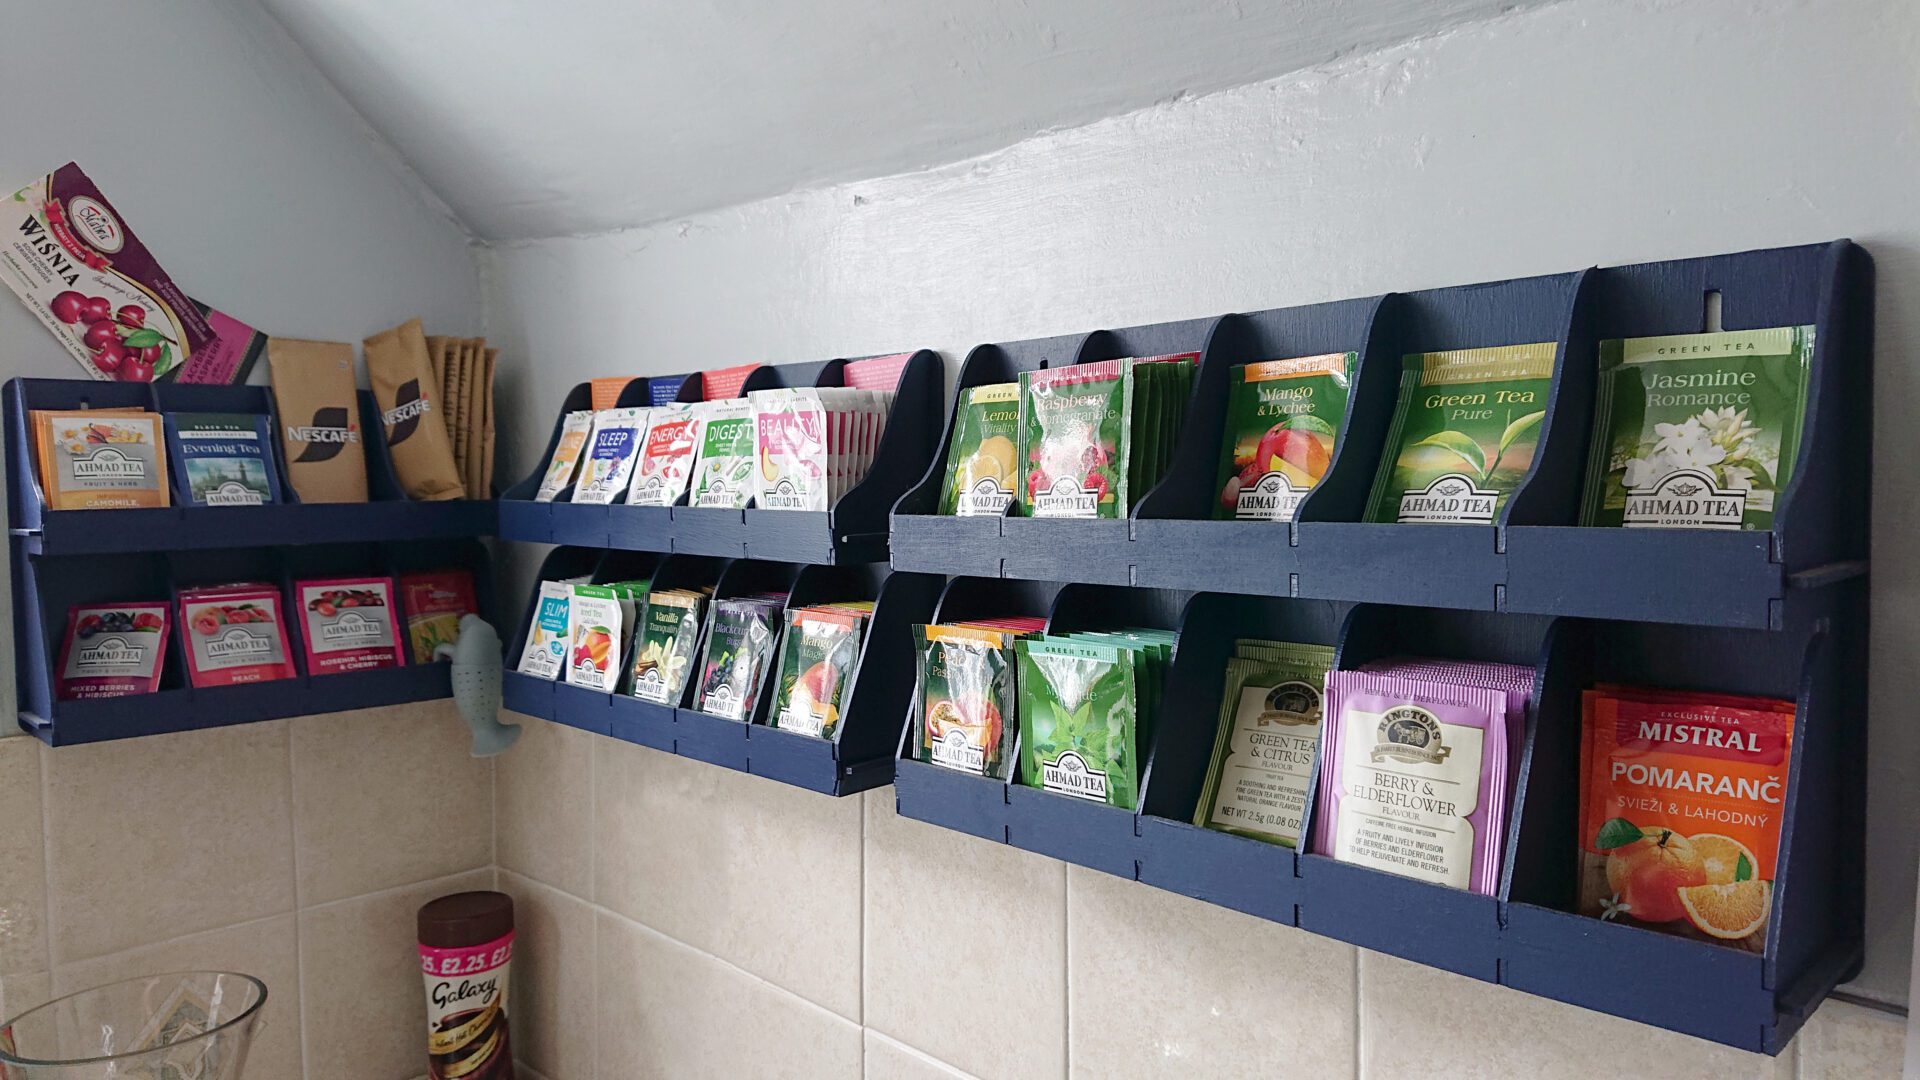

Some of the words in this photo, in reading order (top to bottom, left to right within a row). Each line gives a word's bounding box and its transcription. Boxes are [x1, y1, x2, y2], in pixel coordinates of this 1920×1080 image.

[21, 214, 80, 287] WIŚNIA
[1658, 345, 1711, 354] GREEN
[1724, 342, 1755, 350] TEA
[1646, 369, 1756, 390] Jasmine
[1263, 386, 1313, 402] Mango
[1426, 394, 1486, 408] Green
[1495, 390, 1534, 404] Tea
[1647, 392, 1750, 408] Romance
[1037, 393, 1108, 412] Raspberry
[1258, 408, 1265, 416] &
[1268, 402, 1315, 418] Lychee
[1452, 409, 1493, 421] Pure
[1030, 416, 1036, 427] &
[1039, 409, 1116, 427] Pomegranate
[598, 433, 628, 447] SLEEP
[708, 424, 753, 442] DIGEST
[182, 444, 237, 455] Evening
[238, 444, 261, 454] Tea
[77, 463, 120, 473] AHMAD
[121, 463, 142, 473] TEA
[209, 494, 242, 503] AHMAD
[244, 494, 260, 502] TEA
[767, 496, 792, 507] AHMAD
[991, 497, 1009, 508] TEA
[1036, 498, 1074, 510] AHMAD
[1076, 497, 1096, 510] TEA
[1238, 496, 1280, 509] AHMAD
[1283, 496, 1299, 509] TE
[1401, 499, 1460, 512] AHMAD
[1462, 499, 1492, 513] TEA
[1626, 500, 1699, 516] AHMAD
[1702, 500, 1740, 517] TEA
[544, 602, 568, 618] SLIM
[656, 611, 679, 624] Vanilla
[325, 626, 362, 636] AHMAD
[362, 624, 379, 632] TEA
[210, 642, 249, 653] AHMAD
[250, 640, 268, 650] TEA
[800, 633, 833, 650] Mango
[80, 652, 119, 661] AHMAD
[120, 650, 140, 660] TEA
[1045, 646, 1074, 654] GREEN
[358, 654, 393, 662] HIBISCUS
[347, 661, 378, 670] CHERRY
[232, 674, 260, 682] PEACH
[1364, 688, 1390, 698] BERRY
[704, 699, 726, 711] AHMAD
[1378, 710, 1441, 740] RINGTONS
[1660, 712, 1716, 723] EXCLUSIVE
[1721, 716, 1740, 725] TEA
[1250, 733, 1290, 748] GREEN
[1292, 738, 1316, 752] TEA
[1638, 720, 1762, 752] MISTRAL
[964, 751, 982, 766] TEA
[1250, 746, 1260, 758] &
[1263, 748, 1311, 765] CITRUS
[1261, 761, 1294, 771] FLAVOUR
[1045, 770, 1082, 788] AHMAD
[1083, 776, 1104, 792] TEA
[1242, 780, 1266, 789] SOOTHING
[1374, 772, 1419, 792] BERRY
[1422, 782, 1434, 796] &
[1611, 762, 1782, 804] POMARANČ
[1062, 786, 1085, 796] LONDON
[1236, 786, 1246, 794] FINE
[1246, 788, 1262, 796] GREEN
[1274, 792, 1286, 800] WITH
[1237, 794, 1258, 804] NATURAL
[1259, 799, 1278, 808] ORANGE
[1353, 784, 1456, 817] ELDERFLOWER
[1221, 806, 1234, 816] NET
[1236, 808, 1248, 818] WT
[1248, 810, 1265, 824] 2.5g
[1266, 814, 1286, 827] (0.08
[1287, 818, 1303, 831] OZ)
[1382, 806, 1420, 821] FLAVOUR
[1617, 795, 1662, 813] SVIEŽI
[1668, 802, 1679, 816] &
[1685, 803, 1768, 828] LAHODNÝ
[1416, 829, 1436, 838] INFUSION
[1360, 830, 1380, 838] FRUITY
[1382, 834, 1394, 842] AND
[1394, 836, 1414, 846] LIVELY
[1416, 842, 1444, 853] INFUSION
[1356, 846, 1370, 856] HELP
[1370, 850, 1405, 865] REJUVENATE
[1407, 858, 1419, 868] AND
[1363, 839, 1386, 850] BERRIES
[1388, 845, 1400, 854] AND
[1401, 848, 1444, 864] ELDERFLOWER
[432, 976, 498, 1010] Galaxy
